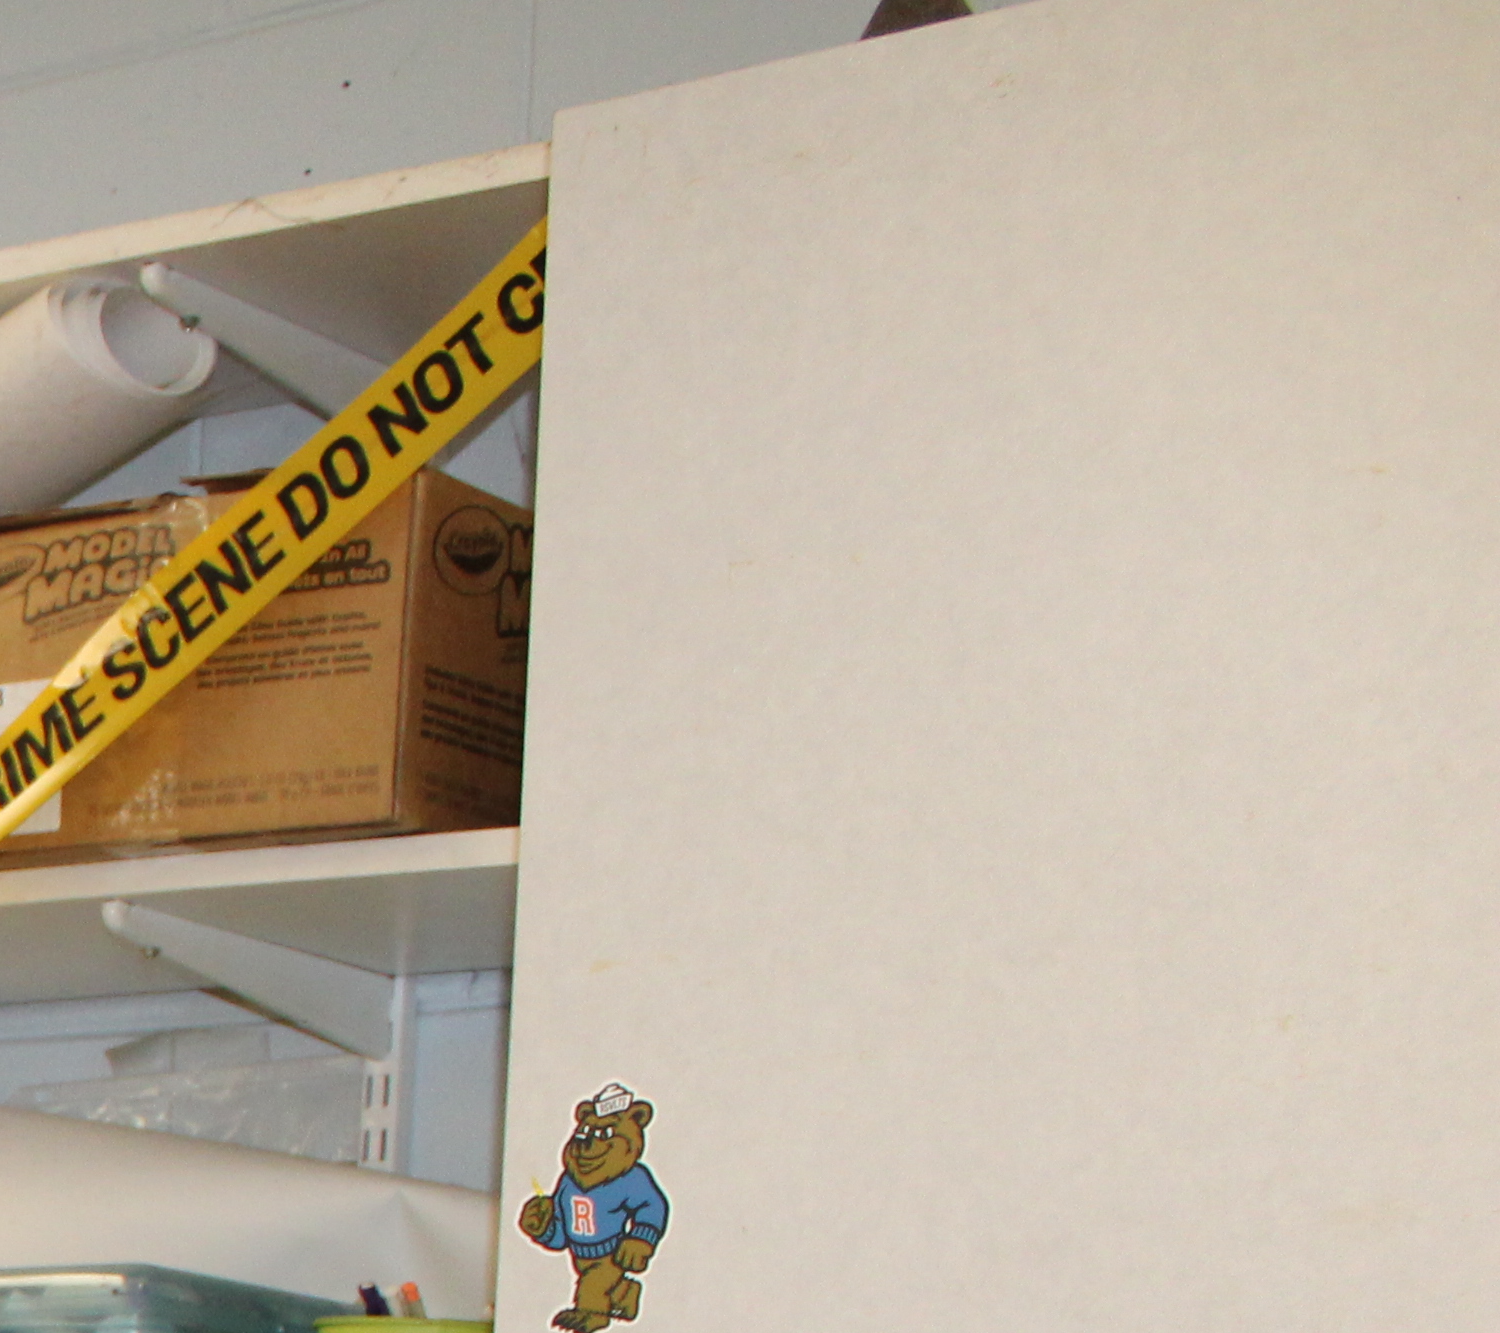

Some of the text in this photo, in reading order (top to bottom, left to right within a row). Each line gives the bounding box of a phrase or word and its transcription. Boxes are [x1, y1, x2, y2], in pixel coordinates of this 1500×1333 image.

[102, 513, 284, 701] SCENE
[277, 437, 371, 541] DO
[368, 312, 493, 457] NOT
[40, 526, 174, 572] MODEL
[572, 1196, 597, 1237] R
